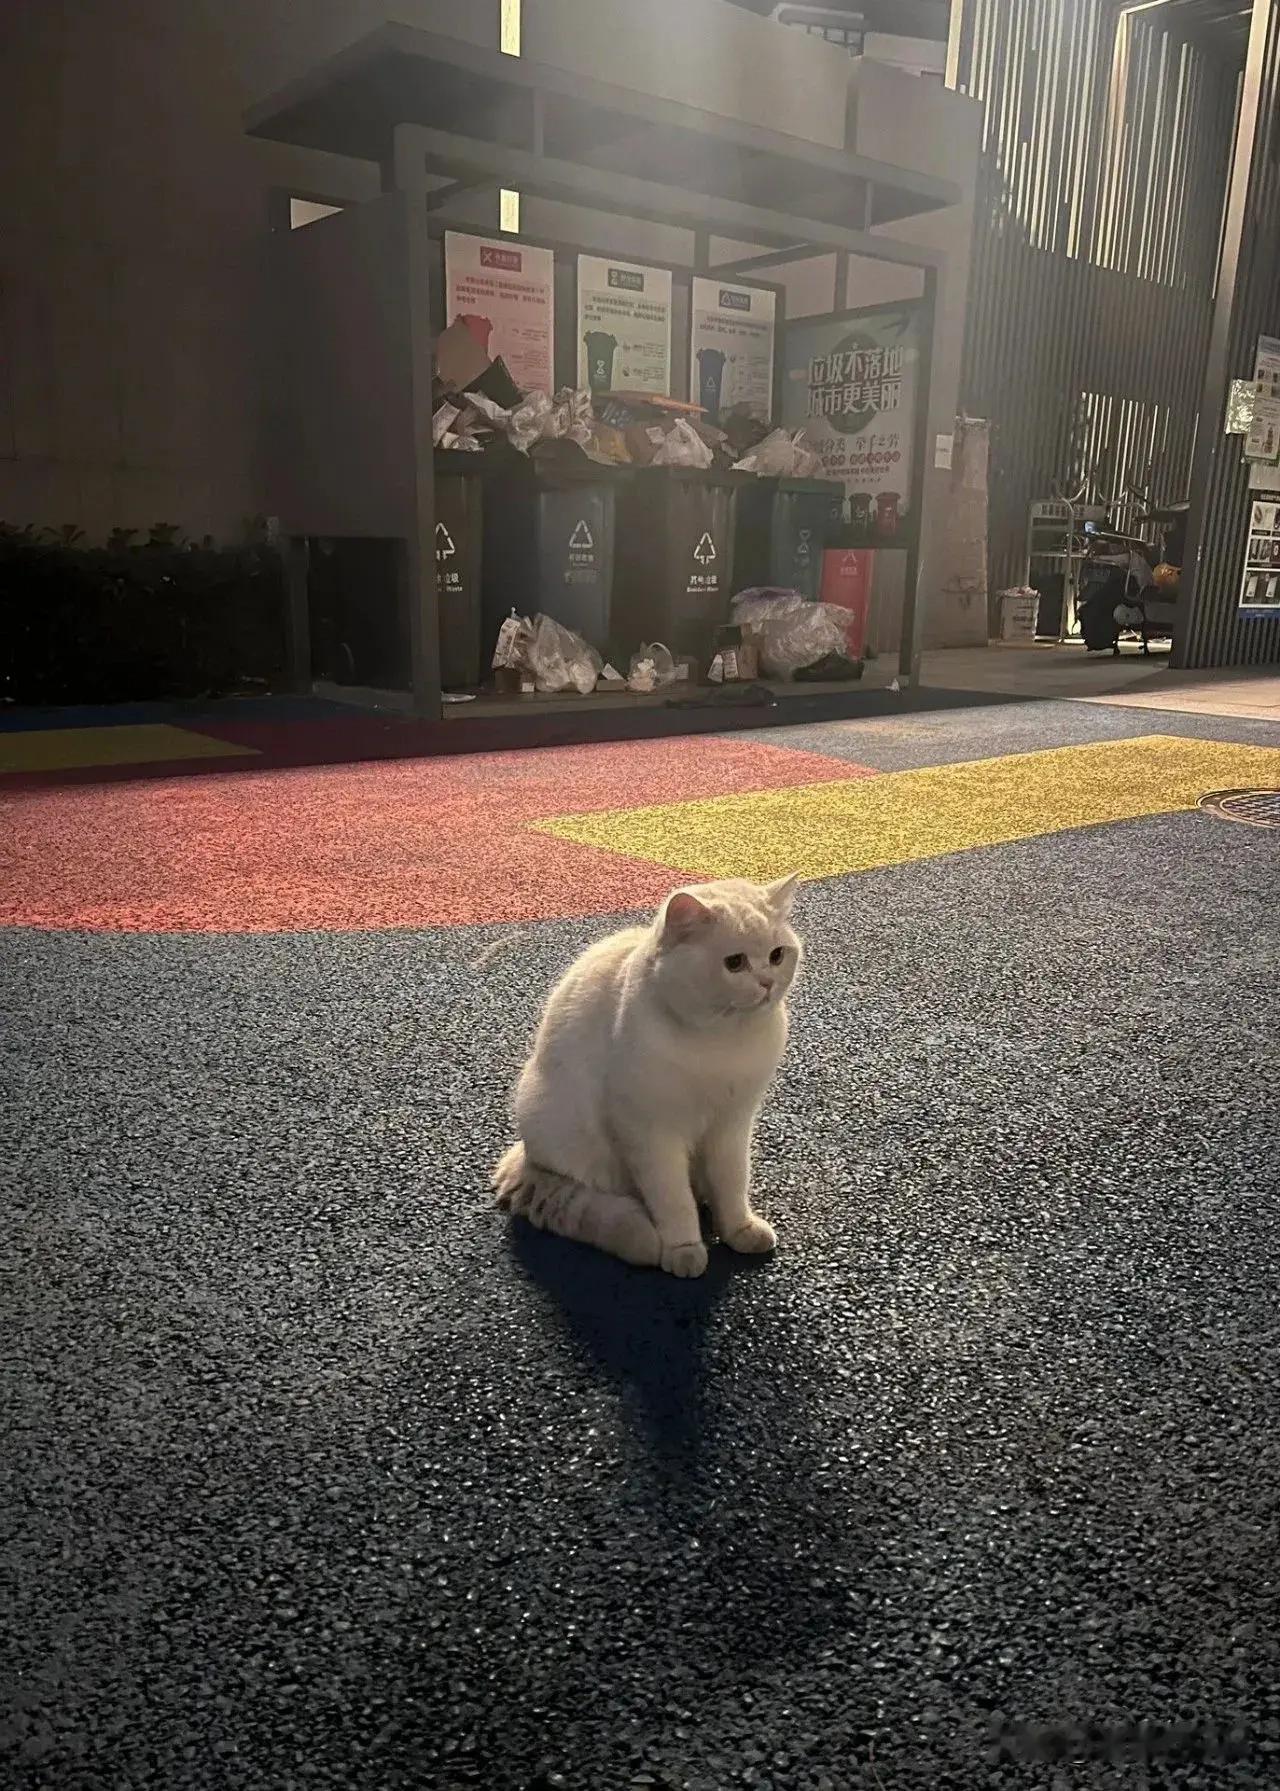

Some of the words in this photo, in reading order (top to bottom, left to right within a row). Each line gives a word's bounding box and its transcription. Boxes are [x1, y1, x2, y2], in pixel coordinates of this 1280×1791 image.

[807, 342, 904, 385] 垃圾不落地
[806, 377, 902, 418] 城市更美丽
